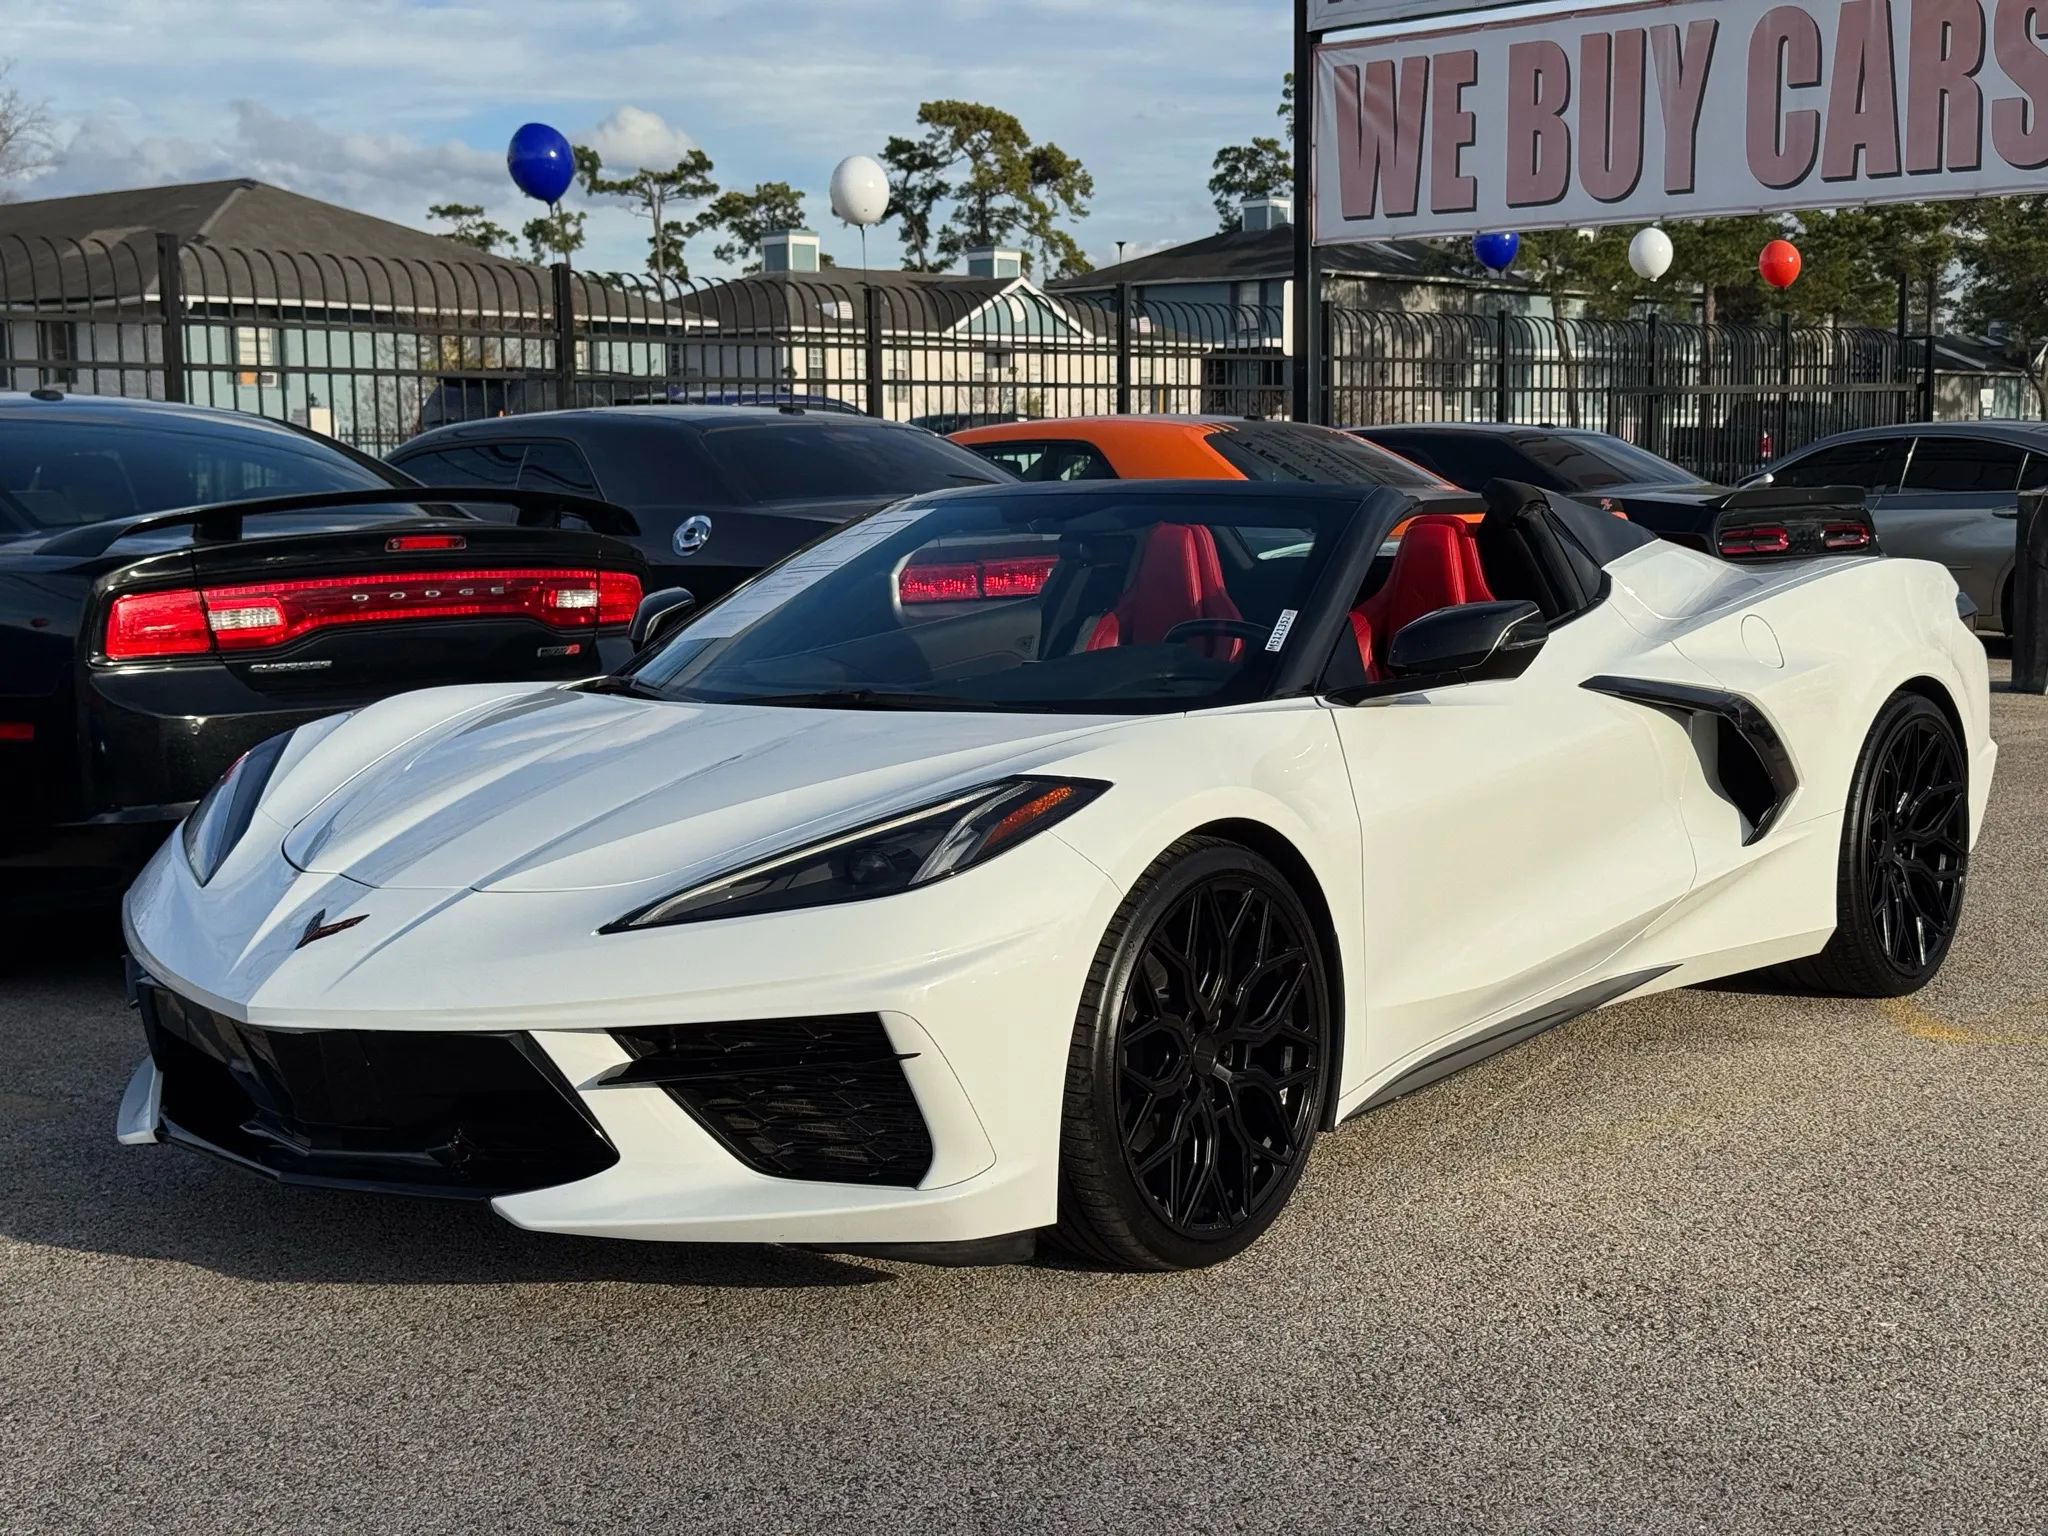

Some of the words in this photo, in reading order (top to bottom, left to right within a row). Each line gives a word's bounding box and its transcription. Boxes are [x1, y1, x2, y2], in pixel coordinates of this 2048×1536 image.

[1333, 50, 1478, 221] WE
[1506, 19, 1719, 208] BUY
[1746, 0, 2048, 190] CARS
[352, 586, 505, 602] DODGE
